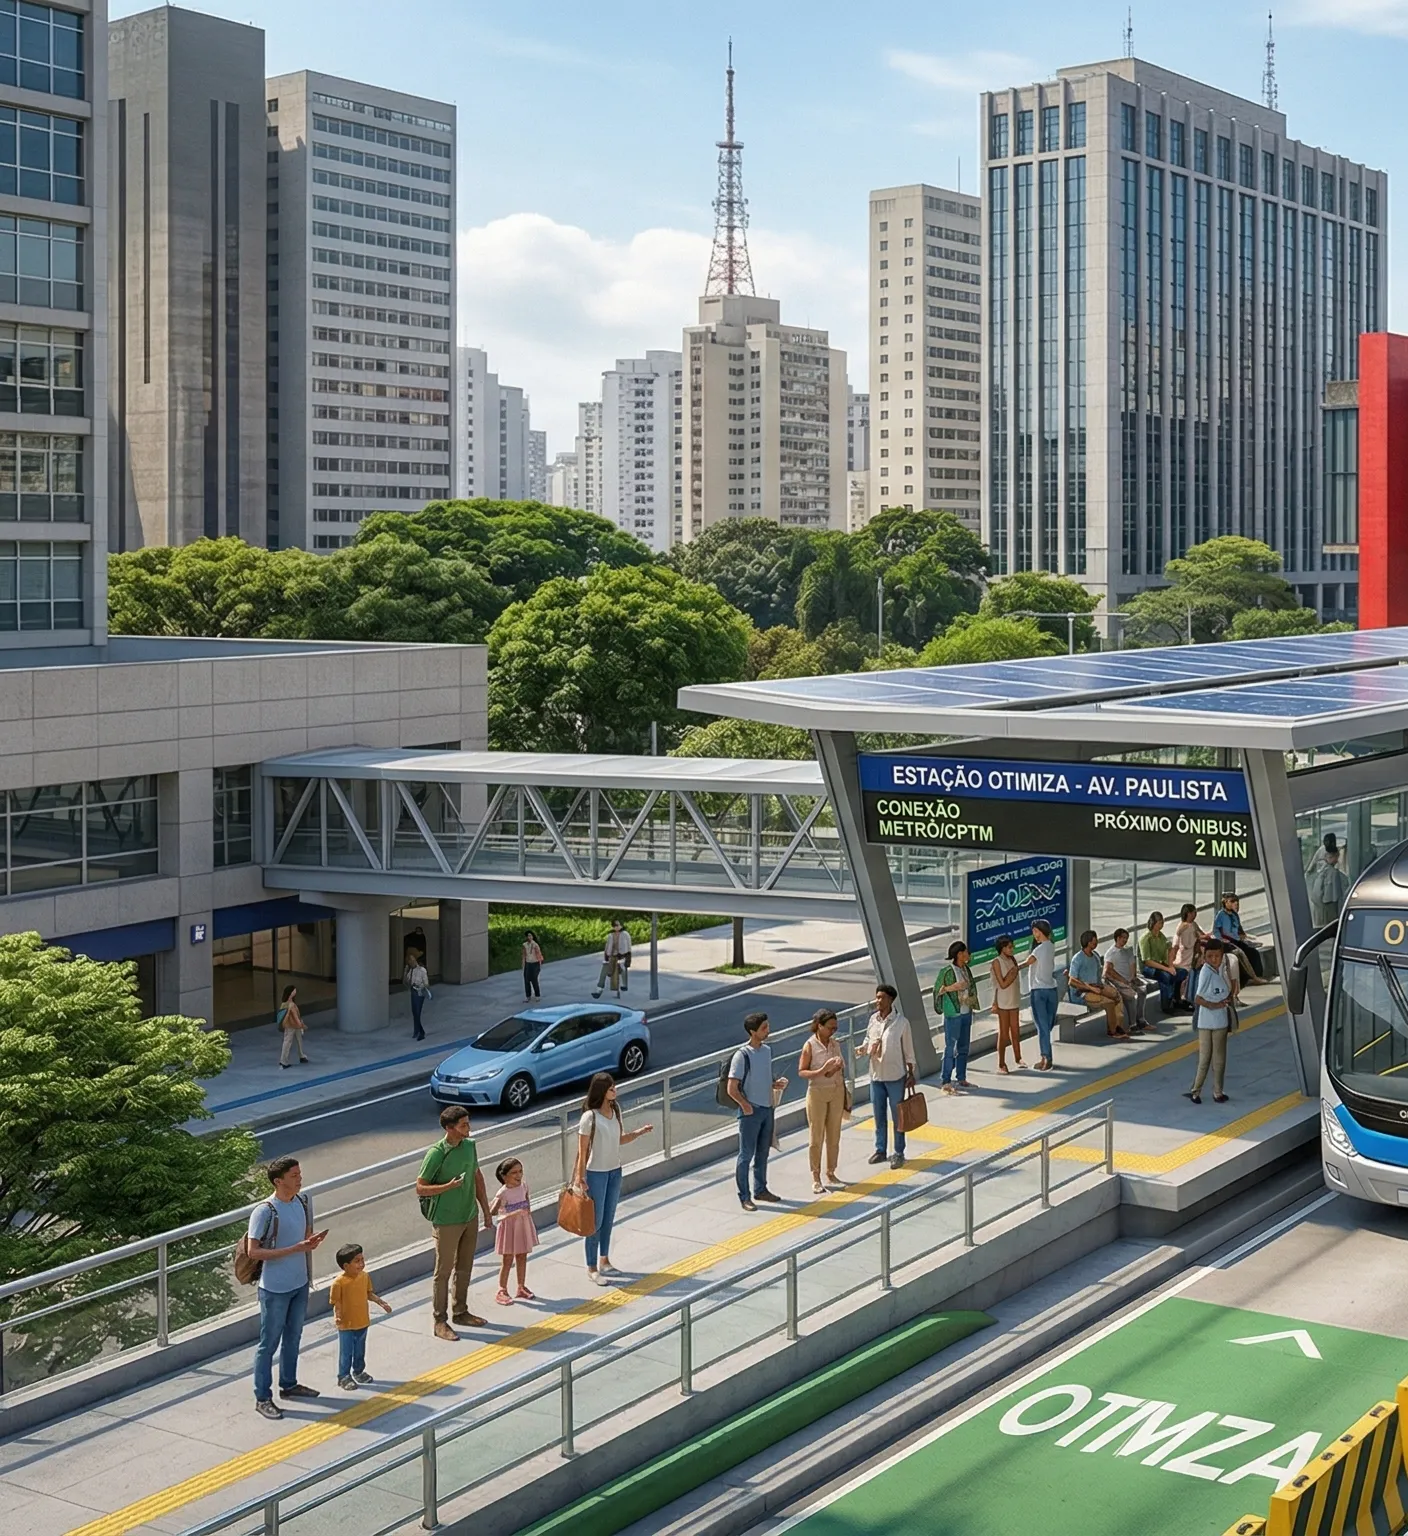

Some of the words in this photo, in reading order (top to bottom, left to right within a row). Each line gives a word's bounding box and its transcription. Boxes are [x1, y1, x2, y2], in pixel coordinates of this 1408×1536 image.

[893, 765, 983, 792] ESTAÇÃO
[988, 771, 1070, 794] OTIMIZA
[1087, 776, 1120, 796] AV.
[1125, 777, 1228, 802] PAULISTA
[877, 799, 961, 819] CONEXÃO
[1094, 810, 1172, 833] PRÓXIMO
[1176, 813, 1248, 837] ÔNIBUS:
[1195, 838, 1206, 856] 2
[1211, 840, 1248, 859] MIN
